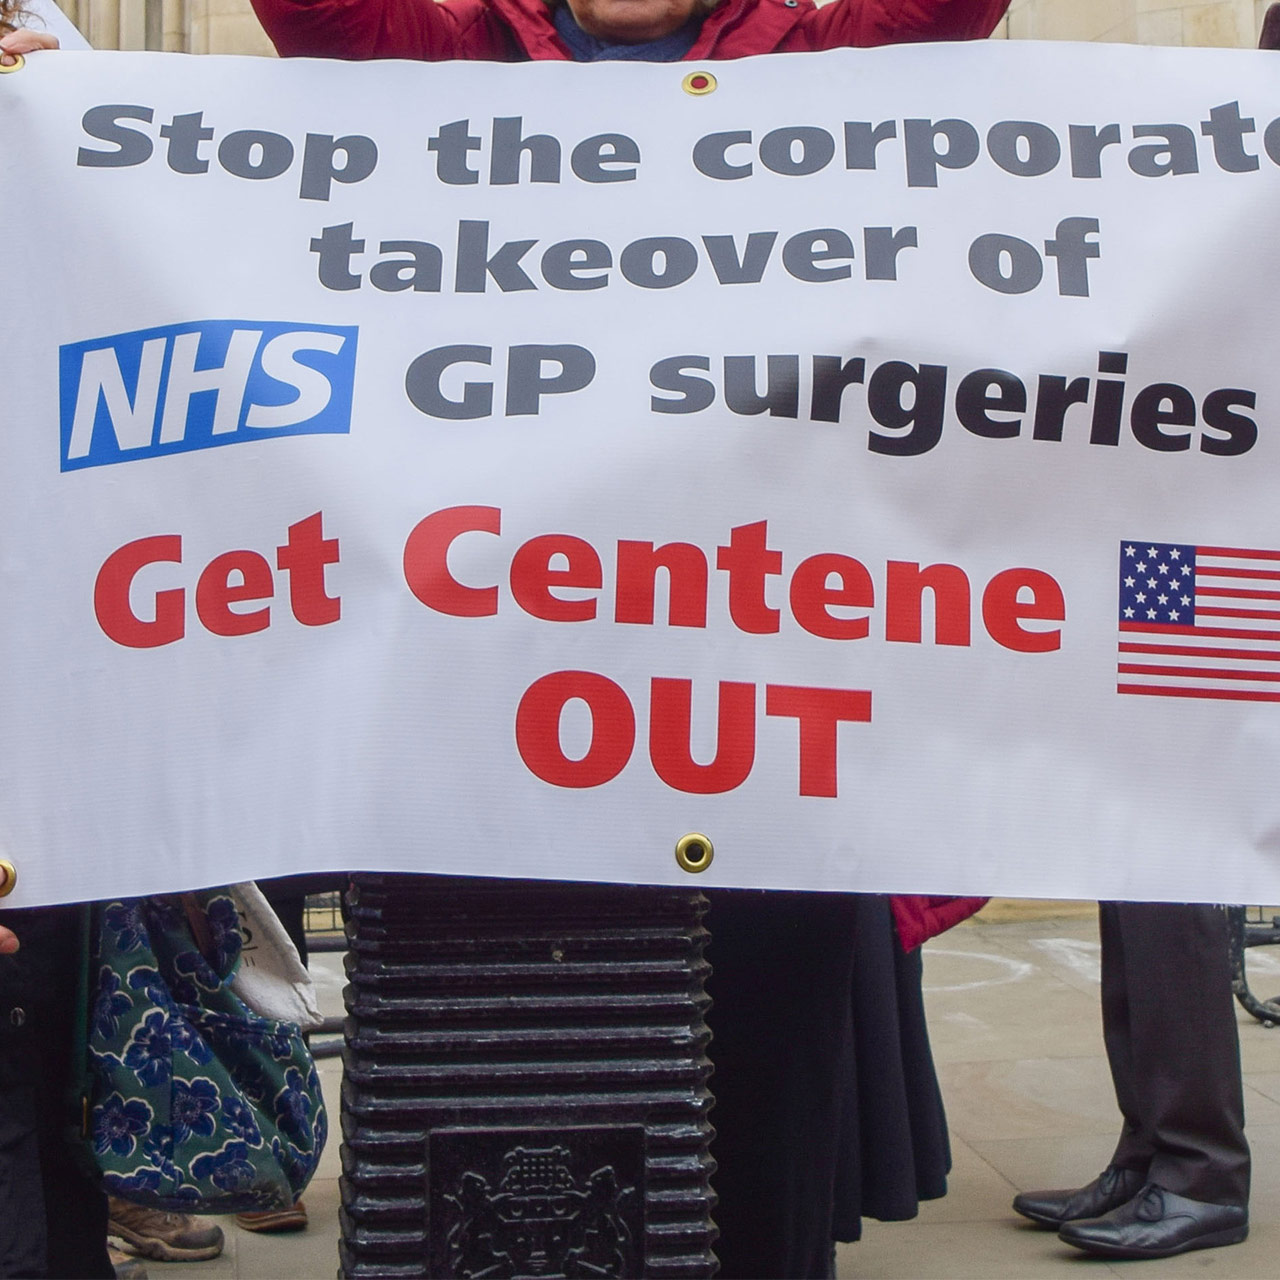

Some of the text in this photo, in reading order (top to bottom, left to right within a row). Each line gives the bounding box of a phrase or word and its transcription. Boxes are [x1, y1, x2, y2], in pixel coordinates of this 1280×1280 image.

[76, 102, 380, 202] Stop
[427, 115, 642, 187] the
[309, 215, 1102, 298] takeover of
[65, 328, 1260, 462] NHS GP surgeries
[92, 504, 1067, 654] Get Centene
[515, 669, 873, 800] OUT
